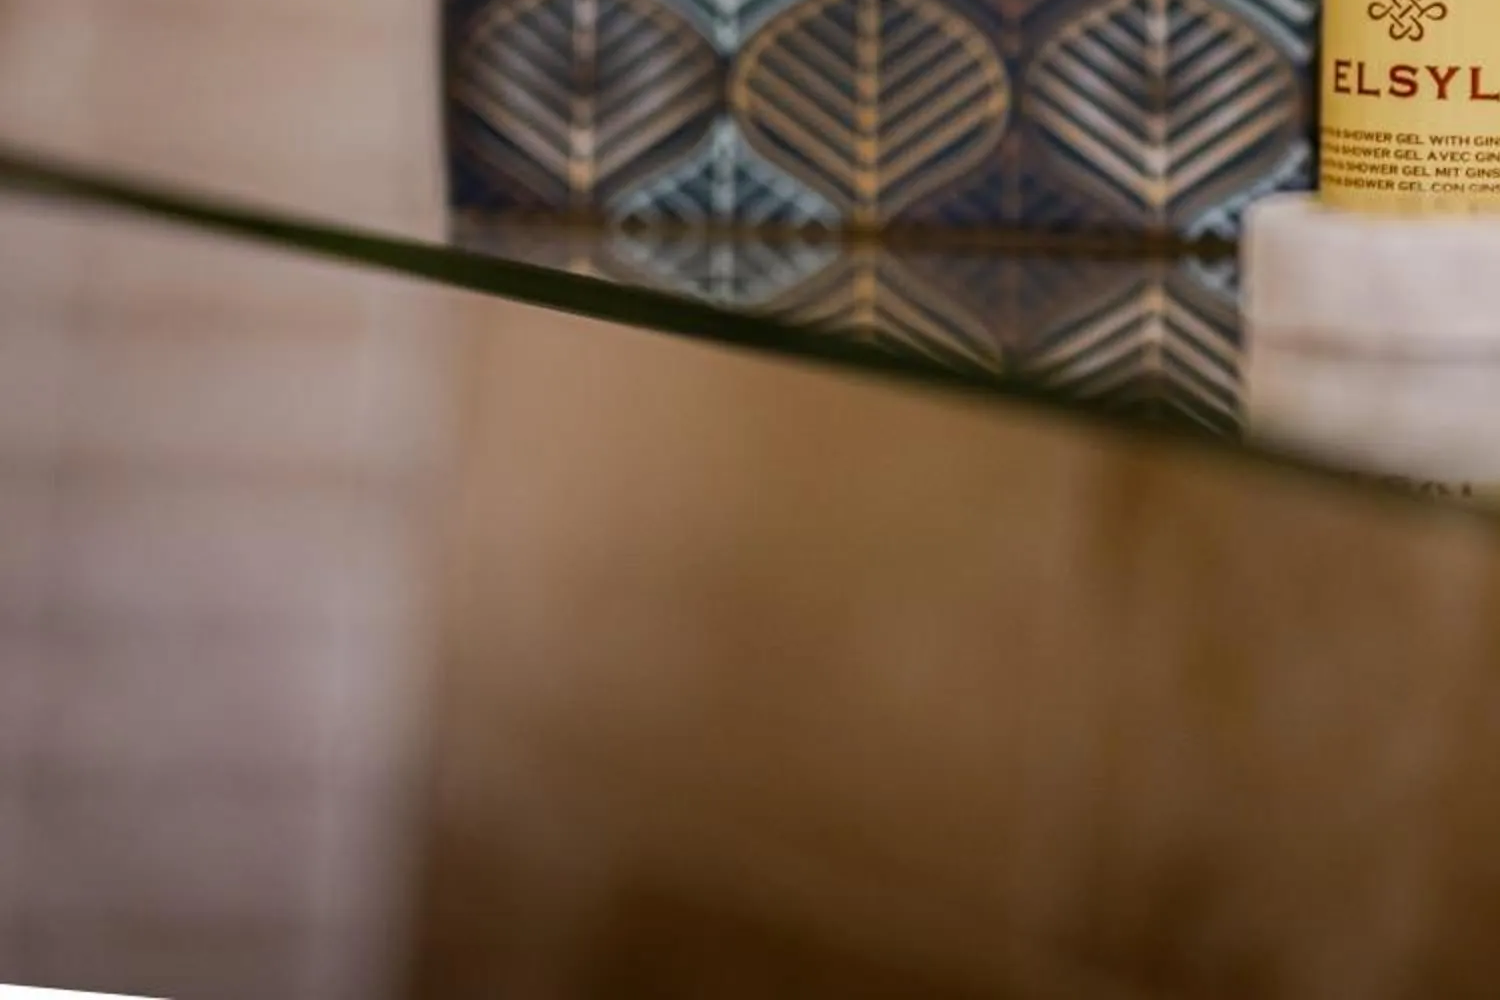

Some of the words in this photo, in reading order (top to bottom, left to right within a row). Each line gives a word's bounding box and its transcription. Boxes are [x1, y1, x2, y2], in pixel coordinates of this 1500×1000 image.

[1395, 132, 1424, 146] GEL
[1428, 135, 1471, 147] WITH
[1393, 148, 1424, 161] GEL
[1427, 150, 1471, 162] AVEC
[1401, 165, 1431, 177] GEL
[1435, 166, 1460, 178] MIT
[1397, 181, 1428, 193] GEL
[1431, 181, 1465, 194] CON
